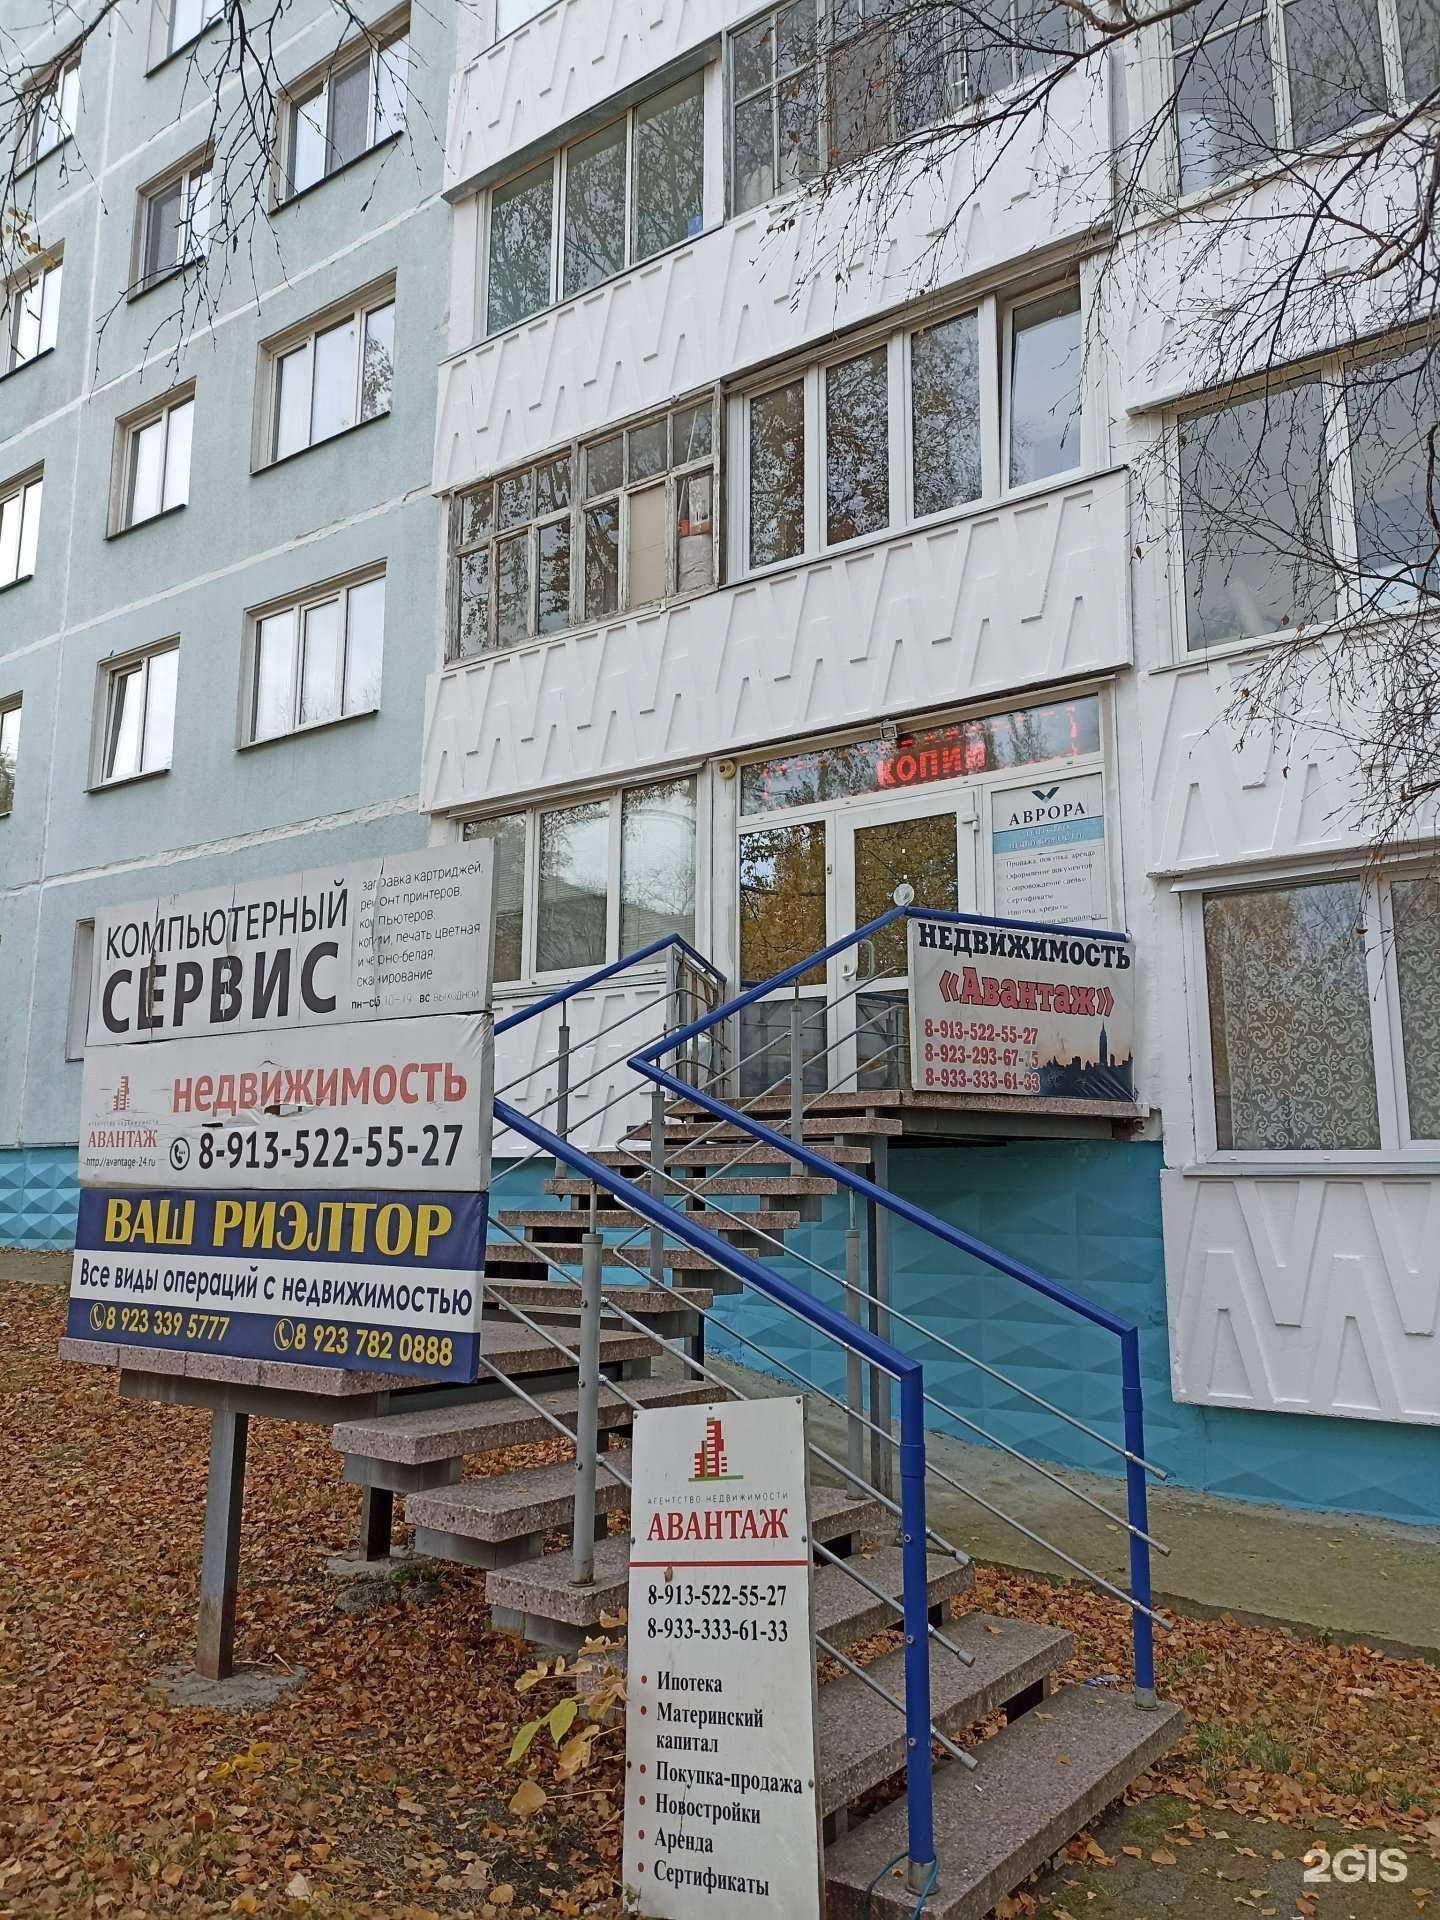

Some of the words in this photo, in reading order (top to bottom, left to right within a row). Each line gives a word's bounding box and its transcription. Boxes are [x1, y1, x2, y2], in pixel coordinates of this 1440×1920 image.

[1009, 801, 1086, 826] АВРОРА
[106, 878, 349, 960] КОМПЬЮТЕРНЫЙ
[396, 930, 432, 943] печать
[435, 923, 480, 940] цветная
[918, 922, 1131, 970] НЕДВИЖИМОСТЬ
[102, 941, 339, 1034] СЕРВИС
[938, 966, 1115, 1017] «Авантаж»
[924, 1018, 1038, 1045] 8-913-522-55-27
[173, 1062, 467, 1117] недвижимость
[925, 1067, 1040, 1092] 8-933-333-61-33
[88, 1129, 158, 1148] АВАНТАЖ
[199, 1124, 463, 1170] 8-913-522-55-27
[104, 1198, 196, 1246] ВАШ
[212, 1200, 452, 1257] РИЭЛТОР
[79, 1260, 110, 1288] Все
[115, 1267, 158, 1295] виды
[164, 1265, 258, 1305] операций
[263, 1277, 276, 1300] с
[281, 1277, 473, 1317] недвижимостью
[106, 1309, 117, 1330] 8
[120, 1310, 149, 1335] 923
[153, 1313, 183, 1338] 339
[187, 1315, 230, 1342] 5777
[294, 1328, 307, 1351] 8
[313, 1329, 349, 1356] 923
[356, 1331, 392, 1360] 782
[399, 1333, 453, 1368] 0888
[647, 1508, 789, 1540] АВАНТАЖ
[648, 1584, 787, 1606] 8-913-522-55-27
[647, 1617, 788, 1642] 8-933-333-61-33
[657, 1670, 722, 1693] Ипотека
[657, 1702, 764, 1729] Материнский
[656, 1734, 719, 1753] капитал
[656, 1761, 803, 1795] Покупка-продажа
[656, 1793, 761, 1825] Новостройки
[654, 1827, 714, 1854] Аренда
[654, 1860, 770, 1896] Сертификаты
